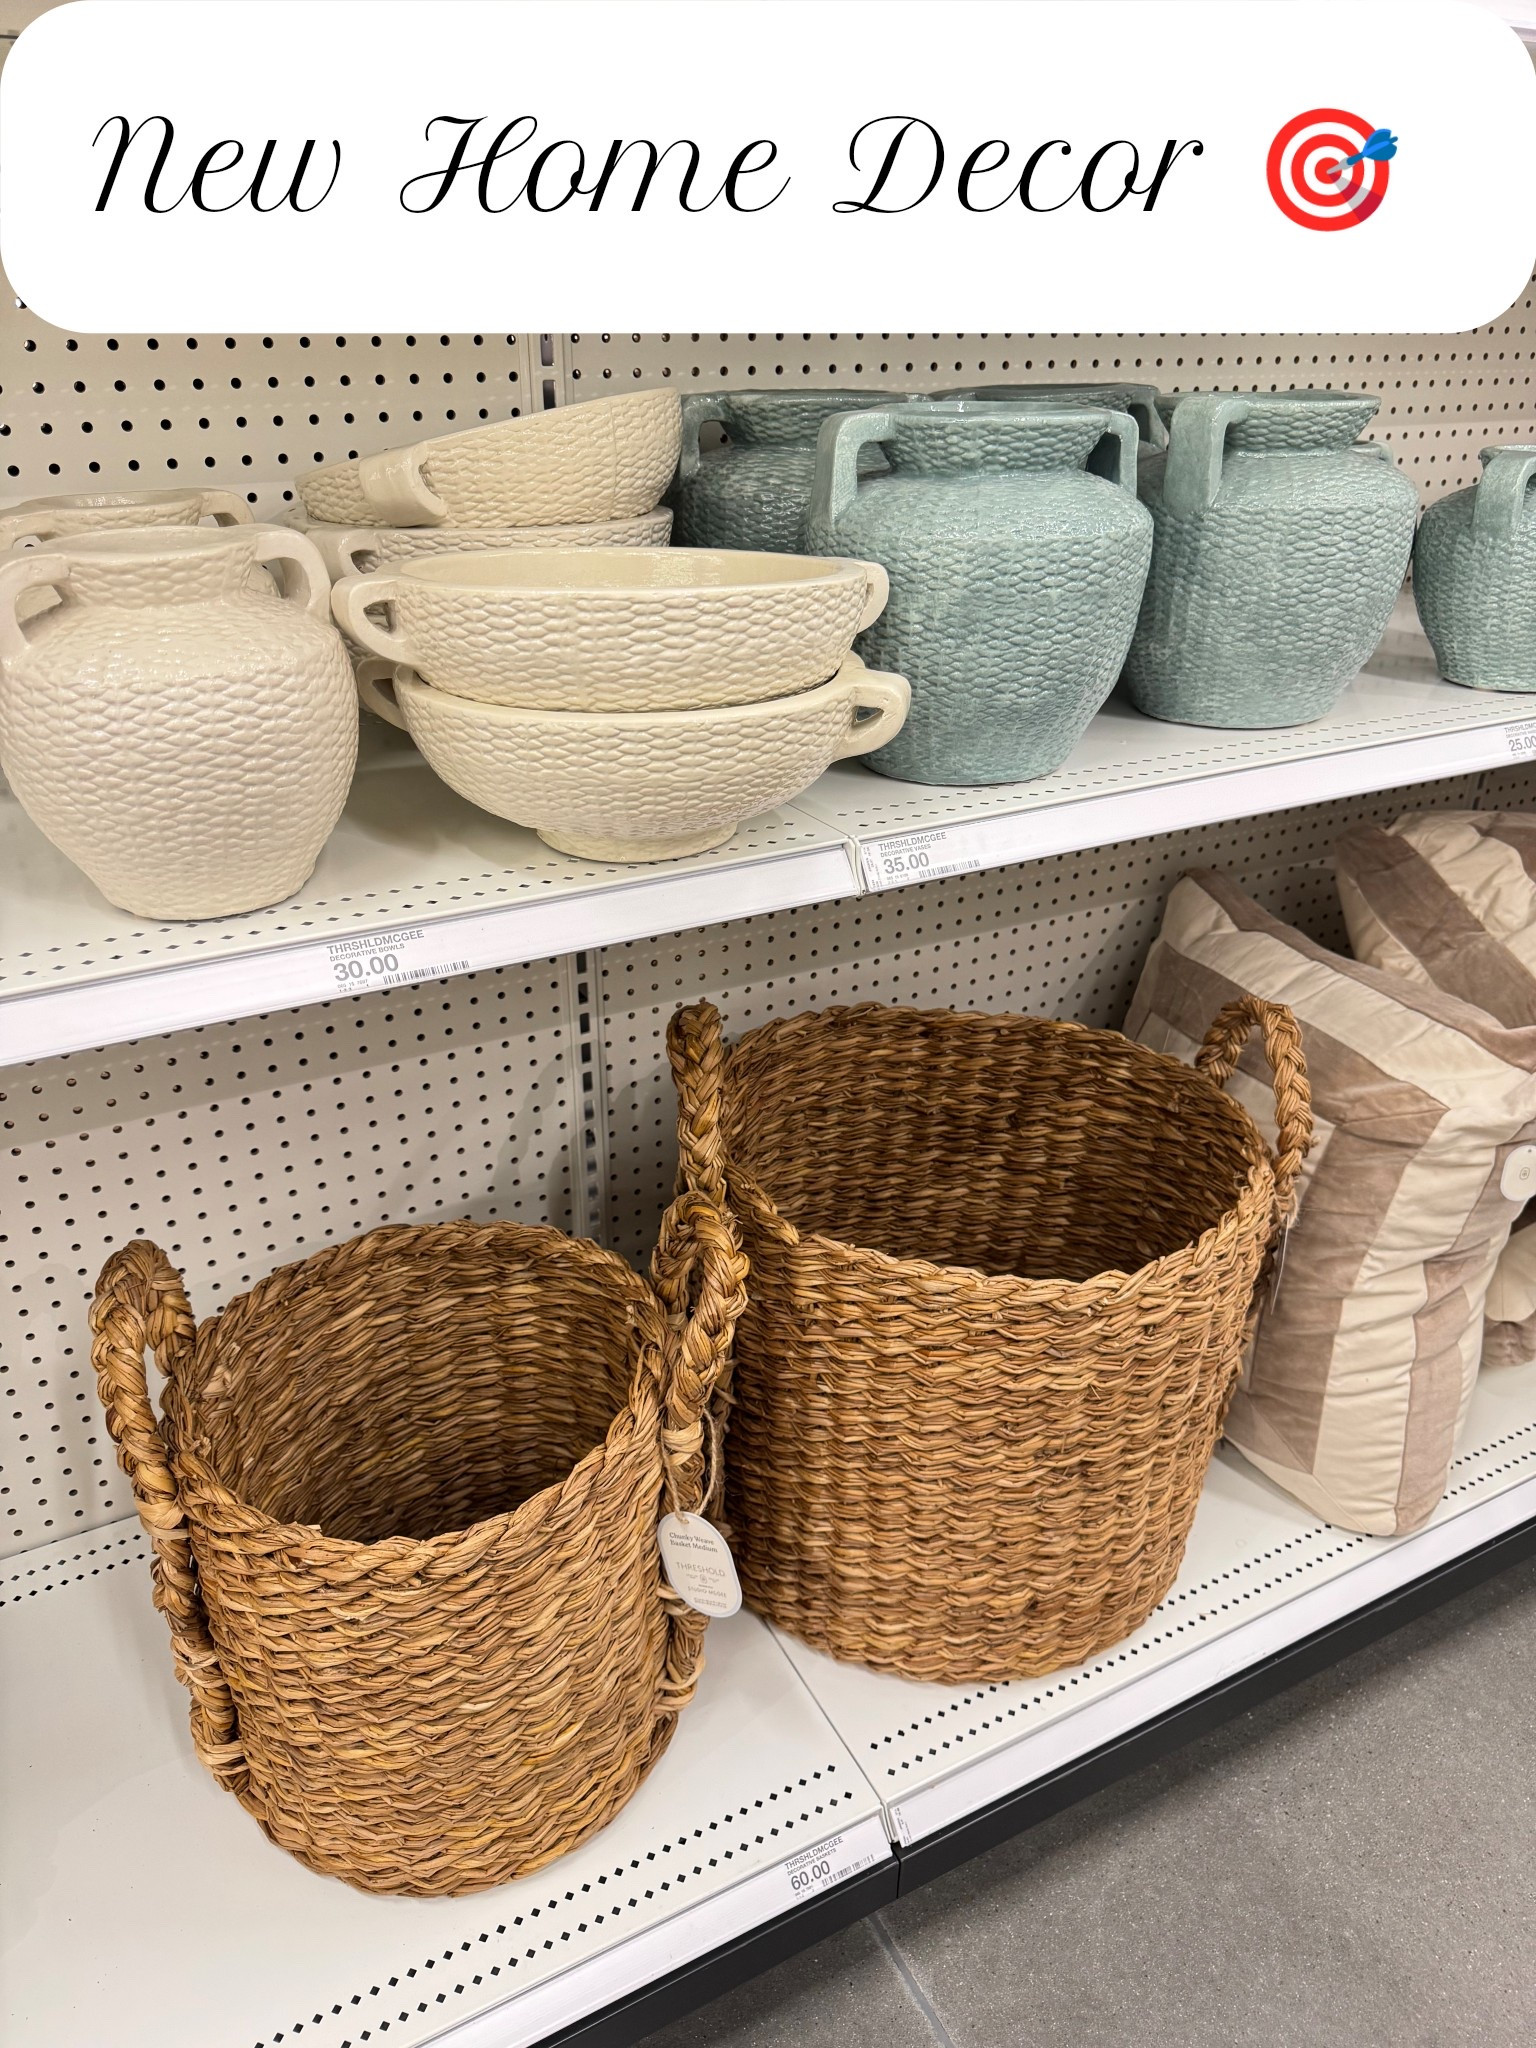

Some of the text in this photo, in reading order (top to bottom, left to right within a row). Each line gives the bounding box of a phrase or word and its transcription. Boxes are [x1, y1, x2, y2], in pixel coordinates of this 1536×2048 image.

[878, 831, 947, 852] THRSHLDMCGEE
[880, 847, 914, 858] DECORATIVE
[883, 851, 930, 875] 35.00
[326, 929, 425, 955] THRSHLDMCGEE
[329, 942, 405, 962] DECORATIVE BOWLS
[333, 953, 399, 982] 30.00
[669, 1532, 714, 1546] Chunky Weave
[669, 1539, 718, 1553] Basket Medium
[676, 1561, 726, 1577] THRESHOLD
[784, 1835, 844, 1870] THRSHLDMCGEE
[787, 1848, 837, 1876] DECORATIVE BASKETS
[791, 1860, 831, 1891] 60.00
